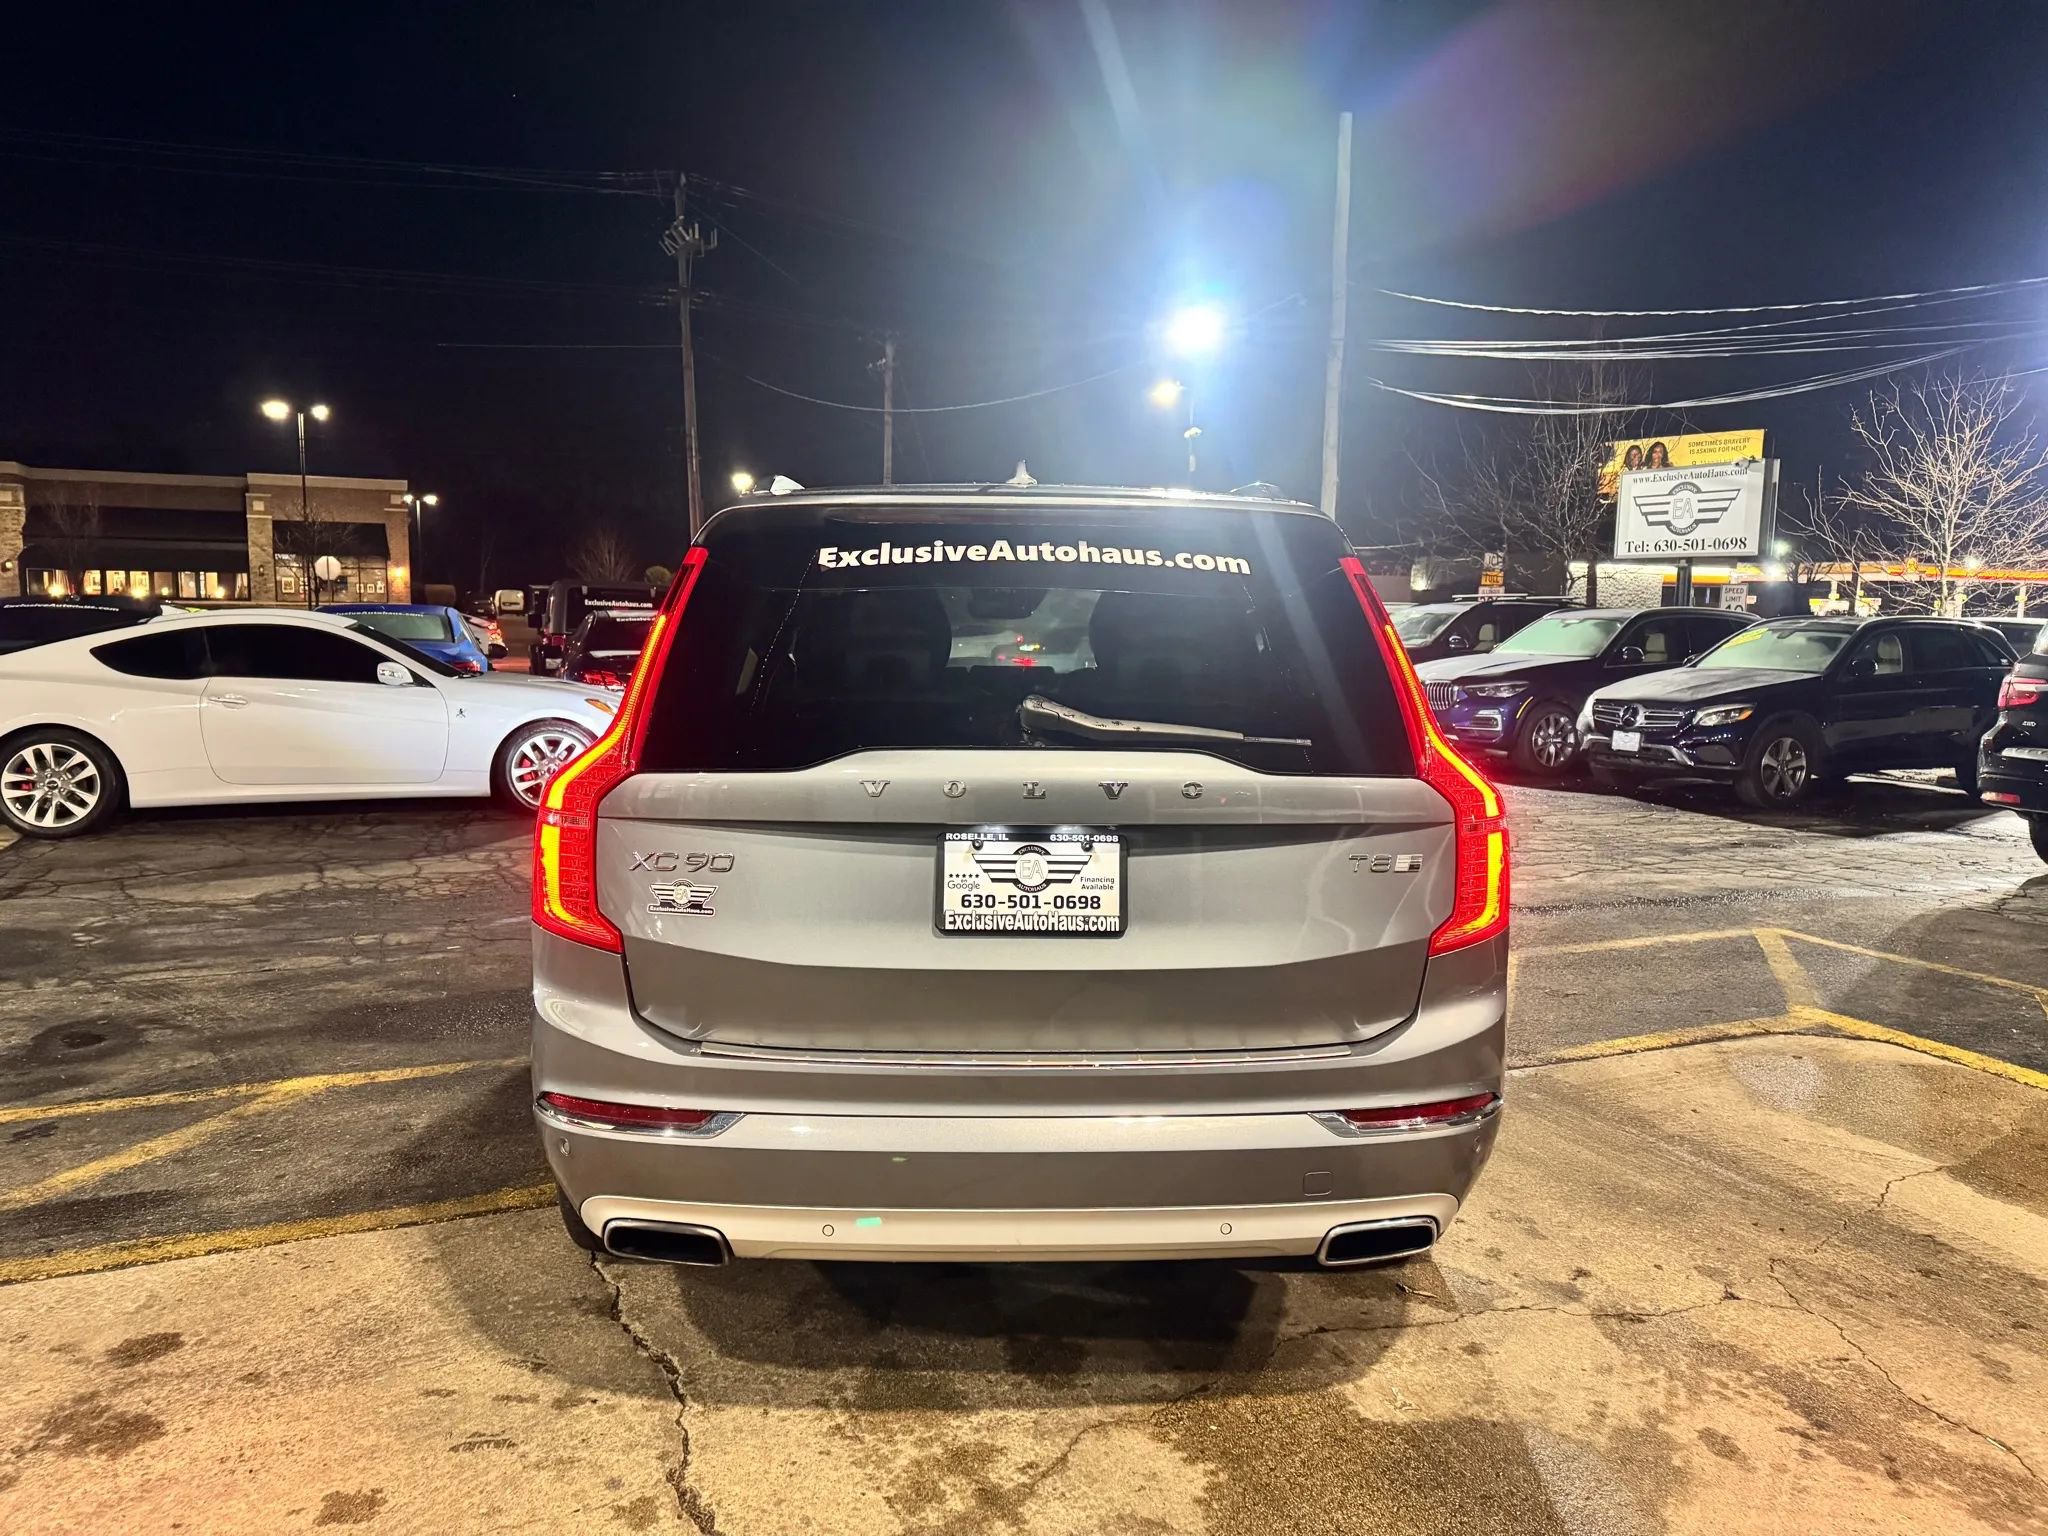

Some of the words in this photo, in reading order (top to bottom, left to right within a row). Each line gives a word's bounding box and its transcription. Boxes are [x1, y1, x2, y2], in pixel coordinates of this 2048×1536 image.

[1688, 439, 1722, 447] SOMETIMES
[1723, 437, 1751, 445] BRAVERY
[1673, 498, 1693, 519] EA
[1625, 541, 1649, 553] Tel:
[1654, 537, 1747, 552] 630-501-0698
[817, 539, 1251, 575] ExclusiveAutohaus.com
[858, 779, 1204, 799] VOLVO
[945, 833, 996, 842] ROSELLE,
[998, 833, 1009, 841] IL
[1050, 834, 1119, 843] 630-501-0698
[1018, 846, 1046, 855] EXCLUSIVE
[1019, 859, 1045, 880] EA
[1349, 853, 1392, 873] T8
[947, 880, 980, 891] Google
[1017, 883, 1047, 892] AUTOHAUS
[1080, 876, 1115, 885] Financing
[961, 894, 1101, 909] 630-501-0698
[945, 910, 1120, 931] ExclusiveAutoHaus.com
